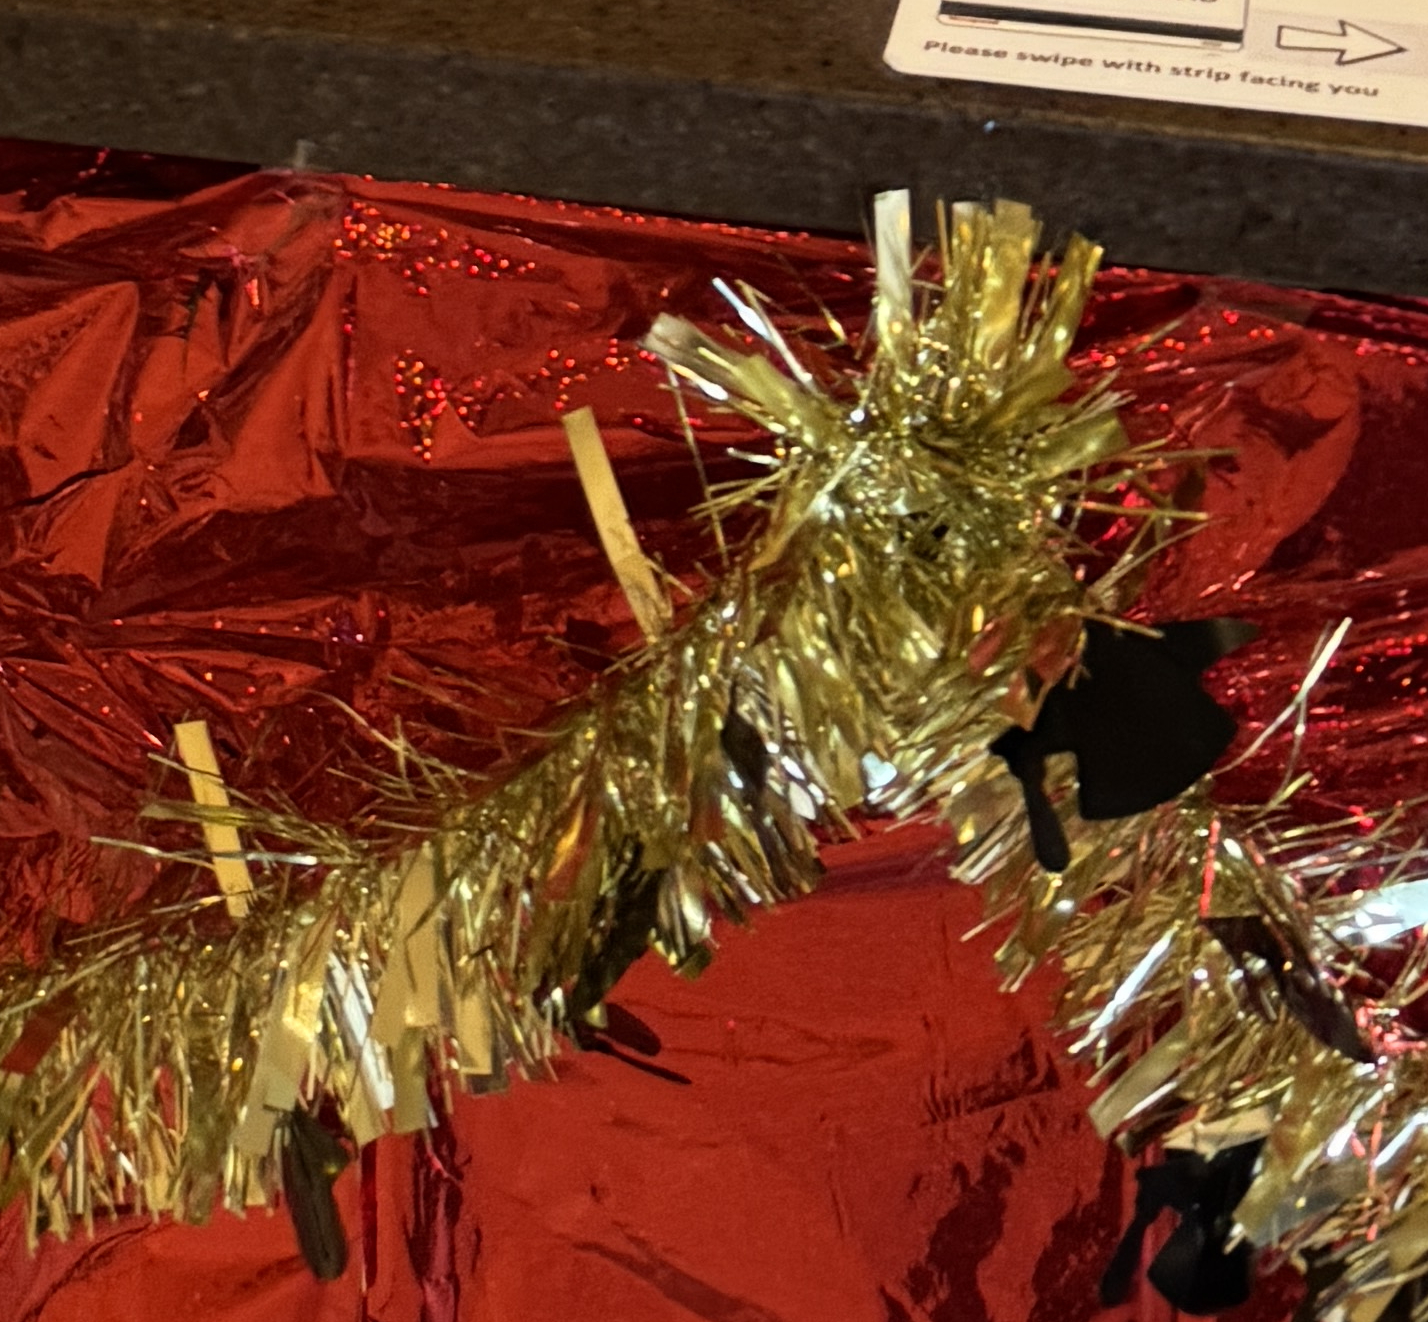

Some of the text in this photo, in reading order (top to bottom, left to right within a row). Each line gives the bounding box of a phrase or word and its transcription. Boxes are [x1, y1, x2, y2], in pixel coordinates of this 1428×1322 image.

[923, 40, 1379, 97] Please swipe with strip facing you
